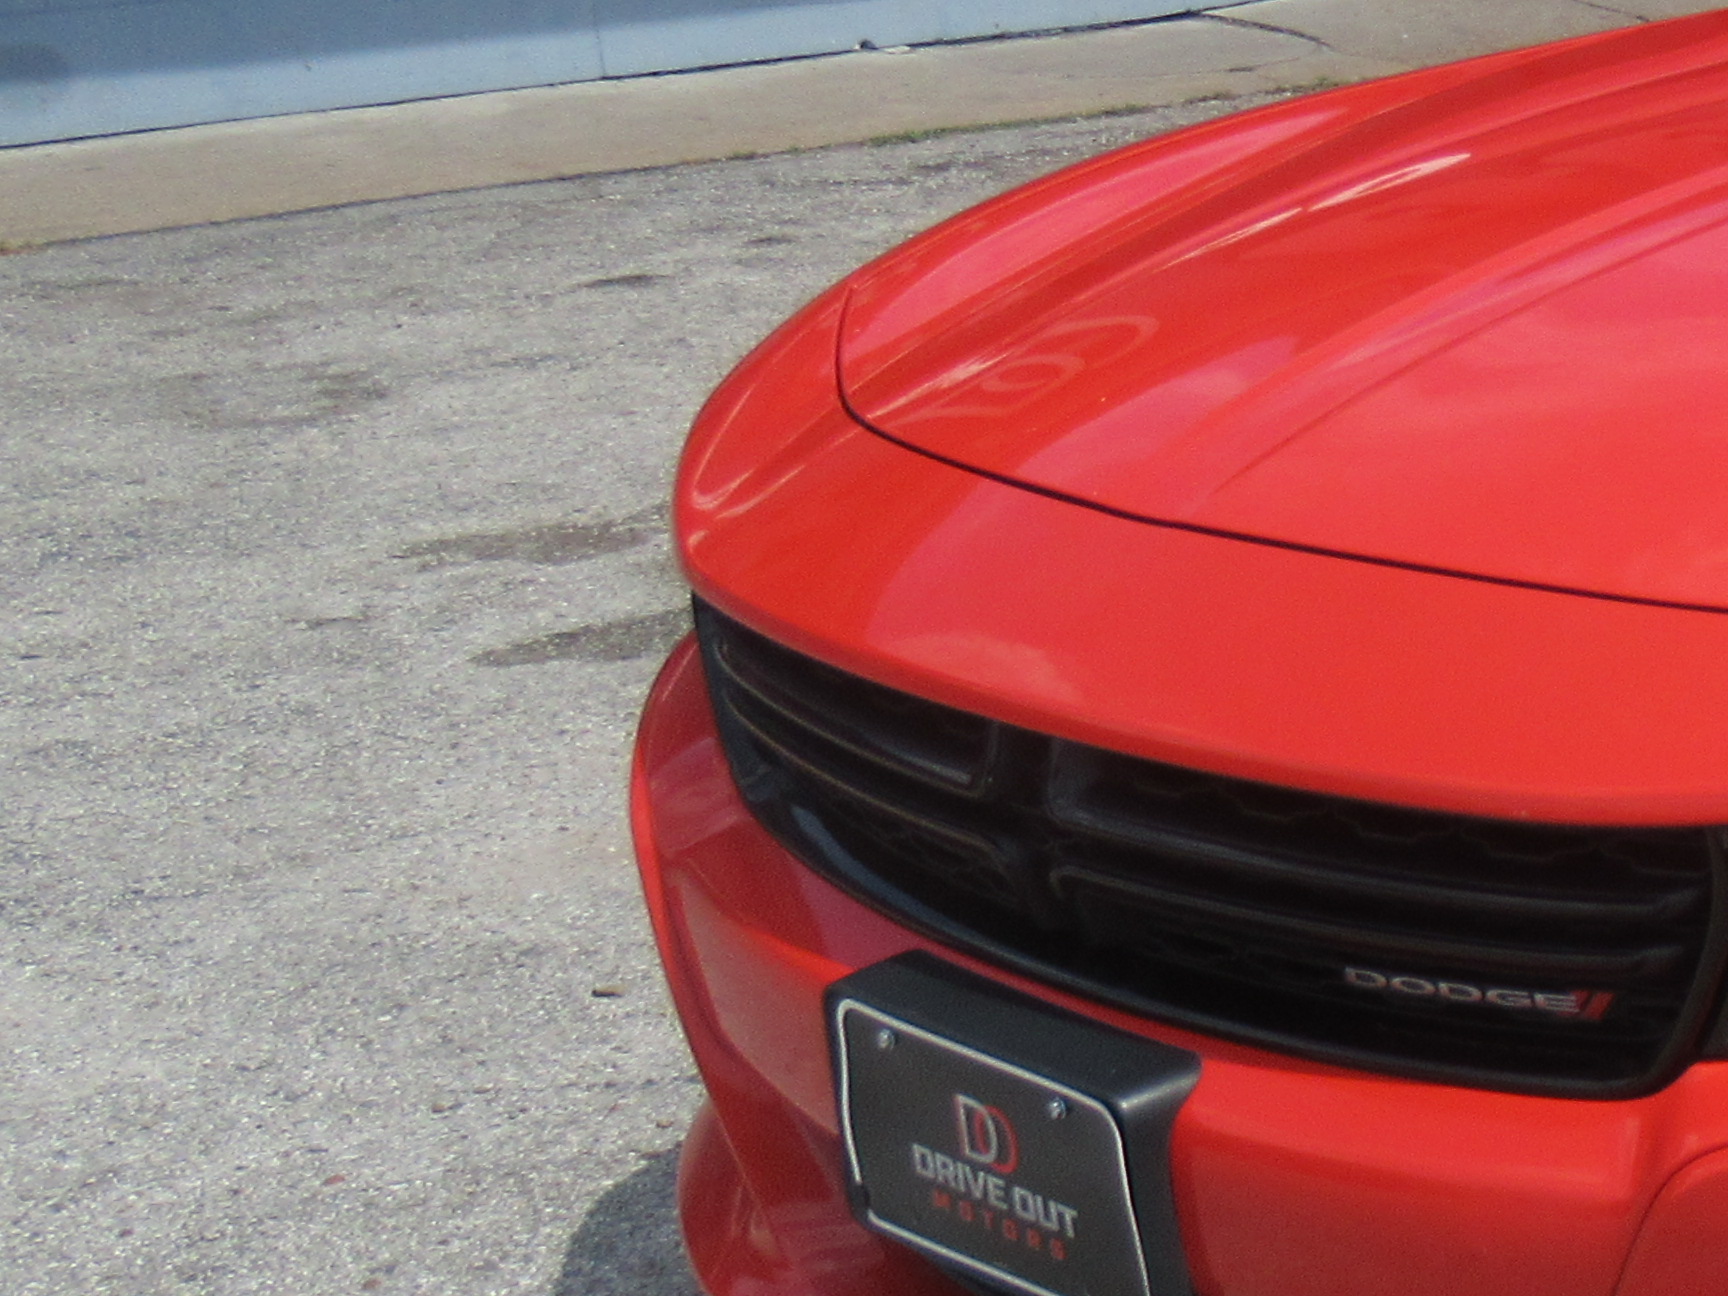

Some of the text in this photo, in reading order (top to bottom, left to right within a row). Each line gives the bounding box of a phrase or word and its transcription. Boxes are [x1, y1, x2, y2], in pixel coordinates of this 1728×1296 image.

[1345, 966, 1580, 1014] DODGE
[911, 1142, 1079, 1239] DRIVE OUT
